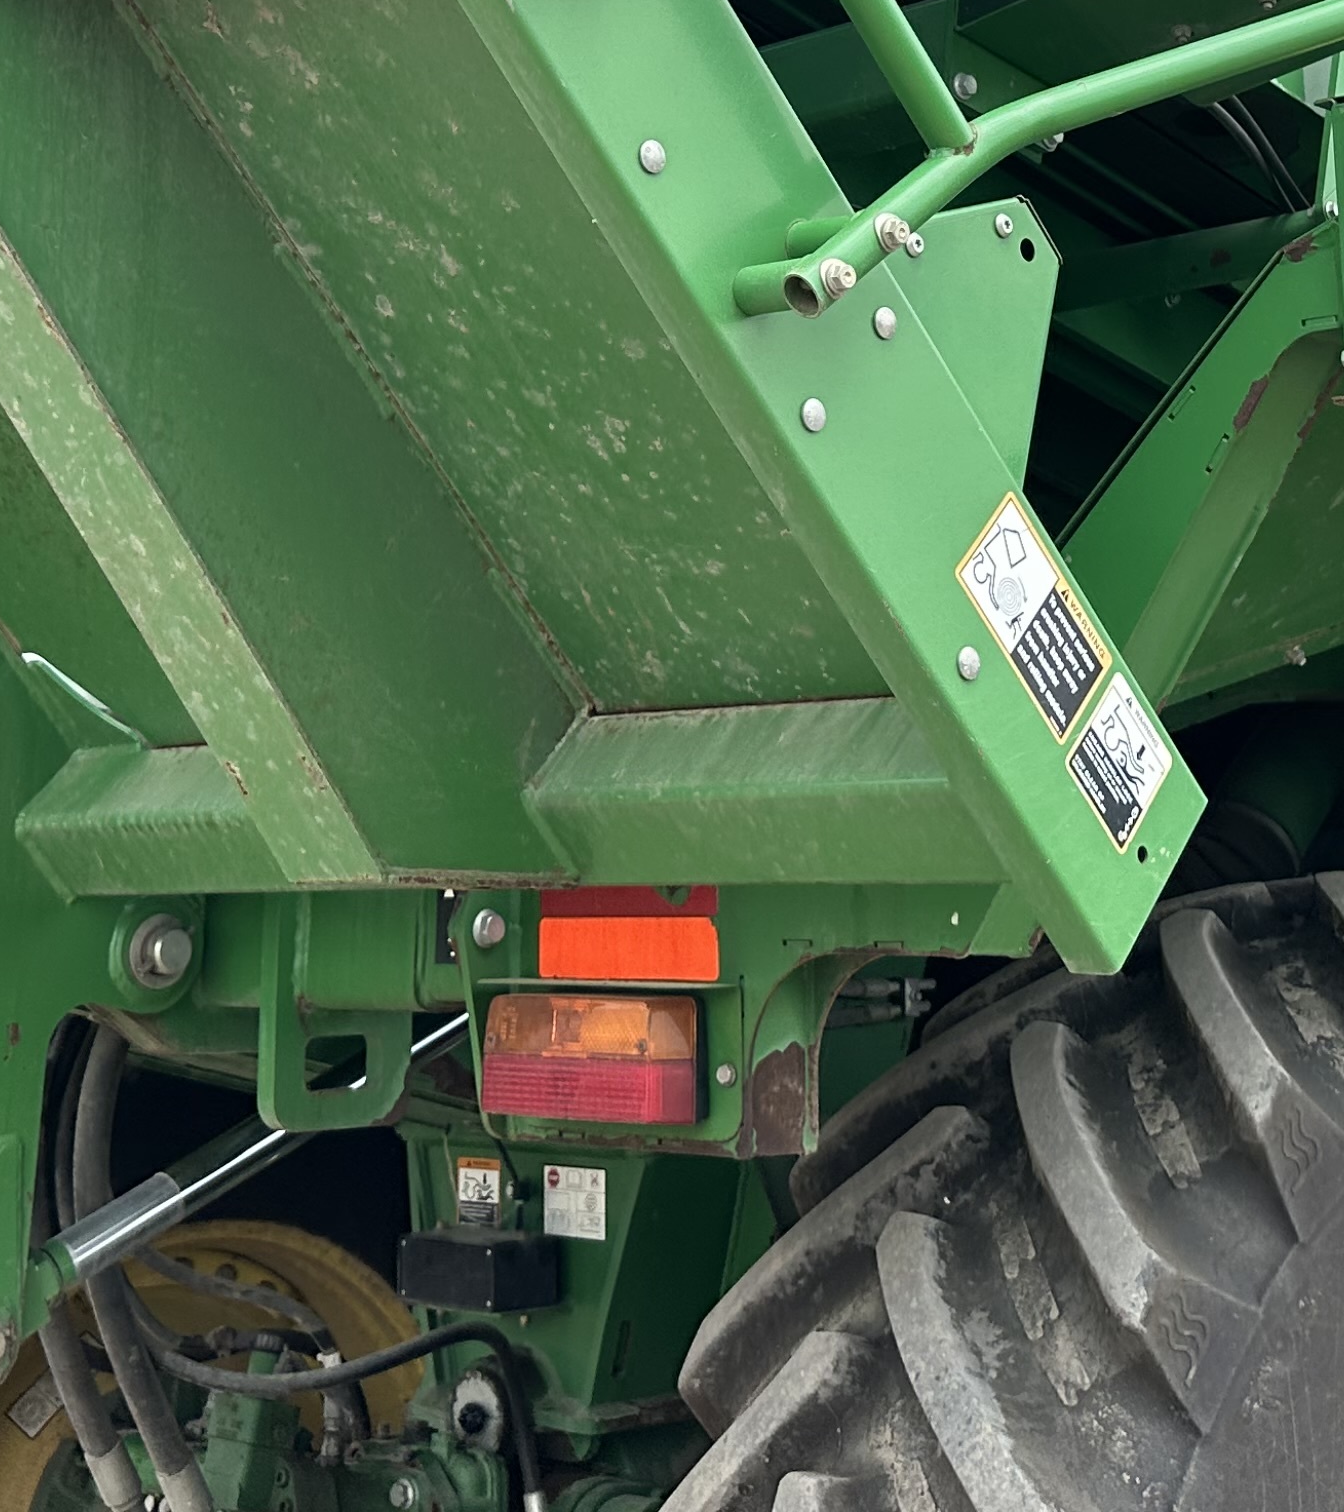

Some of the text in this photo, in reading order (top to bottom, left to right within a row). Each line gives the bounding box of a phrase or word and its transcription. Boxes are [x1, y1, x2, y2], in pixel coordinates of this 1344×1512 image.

[1052, 604, 1077, 644] prevent
[1069, 598, 1106, 660] WARNING
[1132, 707, 1160, 749] WARNING
